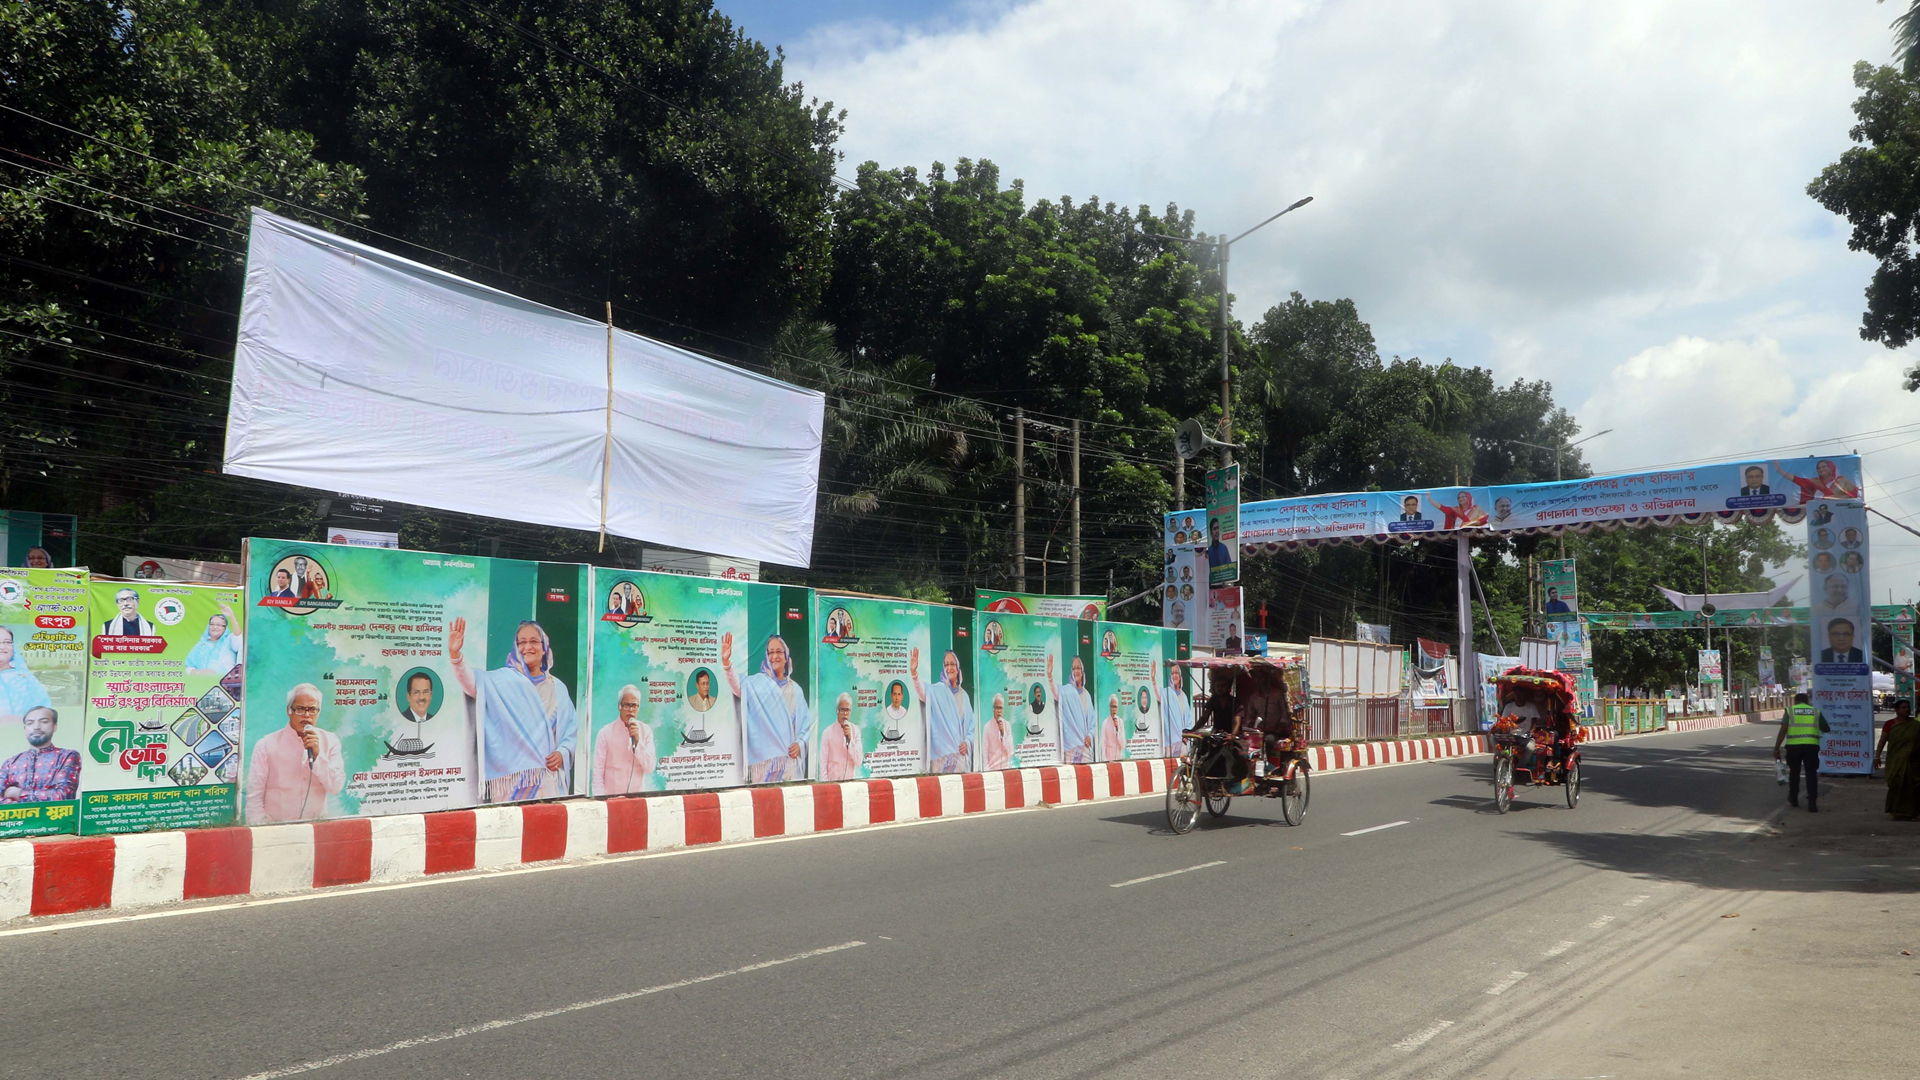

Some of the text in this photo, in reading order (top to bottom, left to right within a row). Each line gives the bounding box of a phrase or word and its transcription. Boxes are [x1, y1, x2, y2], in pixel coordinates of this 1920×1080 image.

[1581, 471, 1696, 491] দেশরত্ন শেখ হাসিনা'র
[1548, 498, 1570, 506] আগমন
[1599, 489, 1647, 501] নীলফামারী-০৩
[1648, 486, 1682, 498] (জলঢাকা)
[1700, 484, 1719, 492] থেকে
[1279, 499, 1367, 515] দেশরত্ন শেখ হাসিনা'র
[1536, 498, 1696, 521] প্রাণঢালা শুভেচ্ছা ও অভিনন্দন
[1242, 529, 1274, 539] প্রাণঢালা
[1277, 525, 1311, 536] শুভেচ্ছা
[1313, 526, 1320, 534] ও
[1323, 521, 1366, 532] অভিনন্দন
[23, 599, 32, 610] ২
[40, 617, 71, 628] রংপুর
[313, 621, 336, 630] মাননীয়
[369, 623, 396, 633] দেশরত্ন
[398, 624, 413, 632] শেখ
[416, 623, 442, 633] হাসিনার
[116, 636, 140, 644] হাসিনার
[381, 648, 408, 657] শুভেচ্ছা
[105, 679, 185, 692] স্মার্ট বাংলাদেশ
[335, 678, 378, 687] মহাসমাবেশ
[336, 688, 377, 696] সফল হোক
[1835, 690, 1846, 699] শেখ
[91, 694, 197, 710] স্মার্ট রংপুর বিনির্মাণে
[334, 696, 377, 706] সার্থক হোক
[1827, 740, 1861, 748] প্রাণঢালা
[120, 744, 167, 770] ভোট
[1820, 747, 1870, 759] অভিনন্দন ও
[137, 761, 166, 782] দিন
[352, 767, 462, 782] মোঃ আনোয়ারুল ইসলাম মায়া
[89, 785, 229, 804] মোঃ কায়সার রাশেদ খান শরিফ
[45, 805, 74, 820] মুন্না
